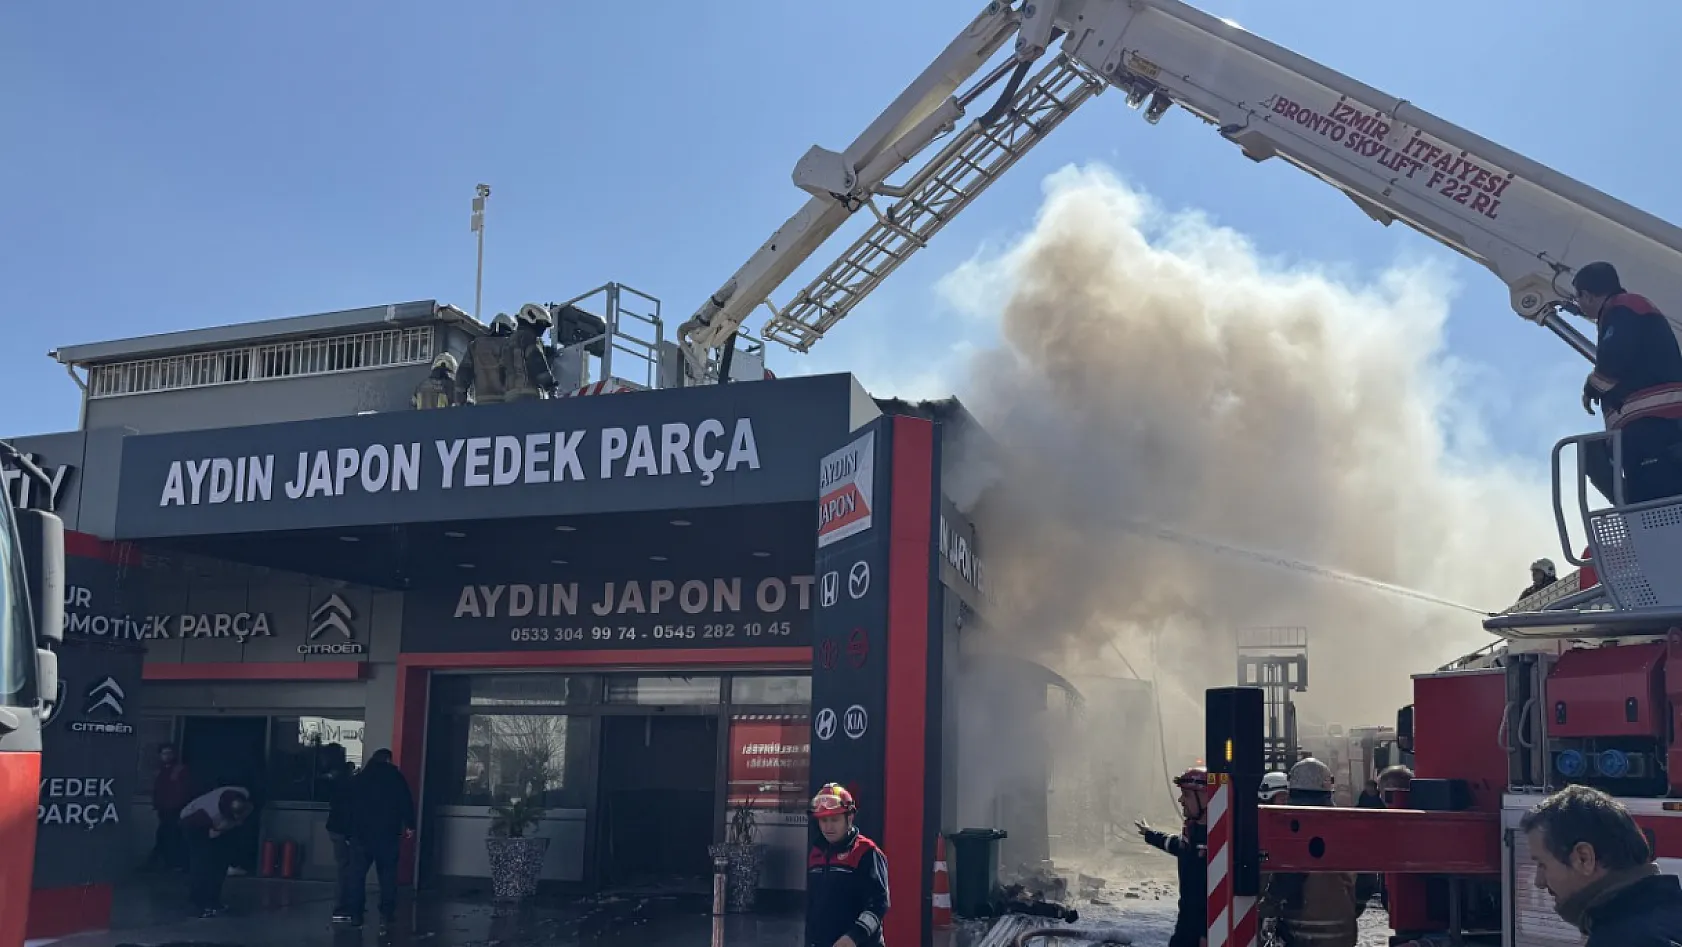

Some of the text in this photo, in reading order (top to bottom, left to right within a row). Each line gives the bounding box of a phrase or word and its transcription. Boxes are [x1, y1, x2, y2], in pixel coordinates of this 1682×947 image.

[1272, 96, 1345, 142] BRONTO
[1344, 131, 1425, 179] SKYLIFT
[1327, 94, 1514, 197] İZMİR İTFAİYESİ
[160, 417, 761, 507] AYDIN JAPON YEDEK PARÇA
[820, 449, 858, 490] AYDIN
[818, 489, 857, 532] JAPON
[453, 574, 816, 618] AYDIN JAPON OT
[179, 612, 271, 643] PARÇA
[510, 627, 550, 642] 0533
[554, 627, 584, 642] 304
[591, 626, 612, 641] 99
[617, 626, 637, 641] 74
[653, 624, 696, 640] 0545
[702, 623, 735, 639] 282
[743, 622, 762, 637] 10
[767, 621, 791, 636] 45
[847, 712, 864, 731] KIA
